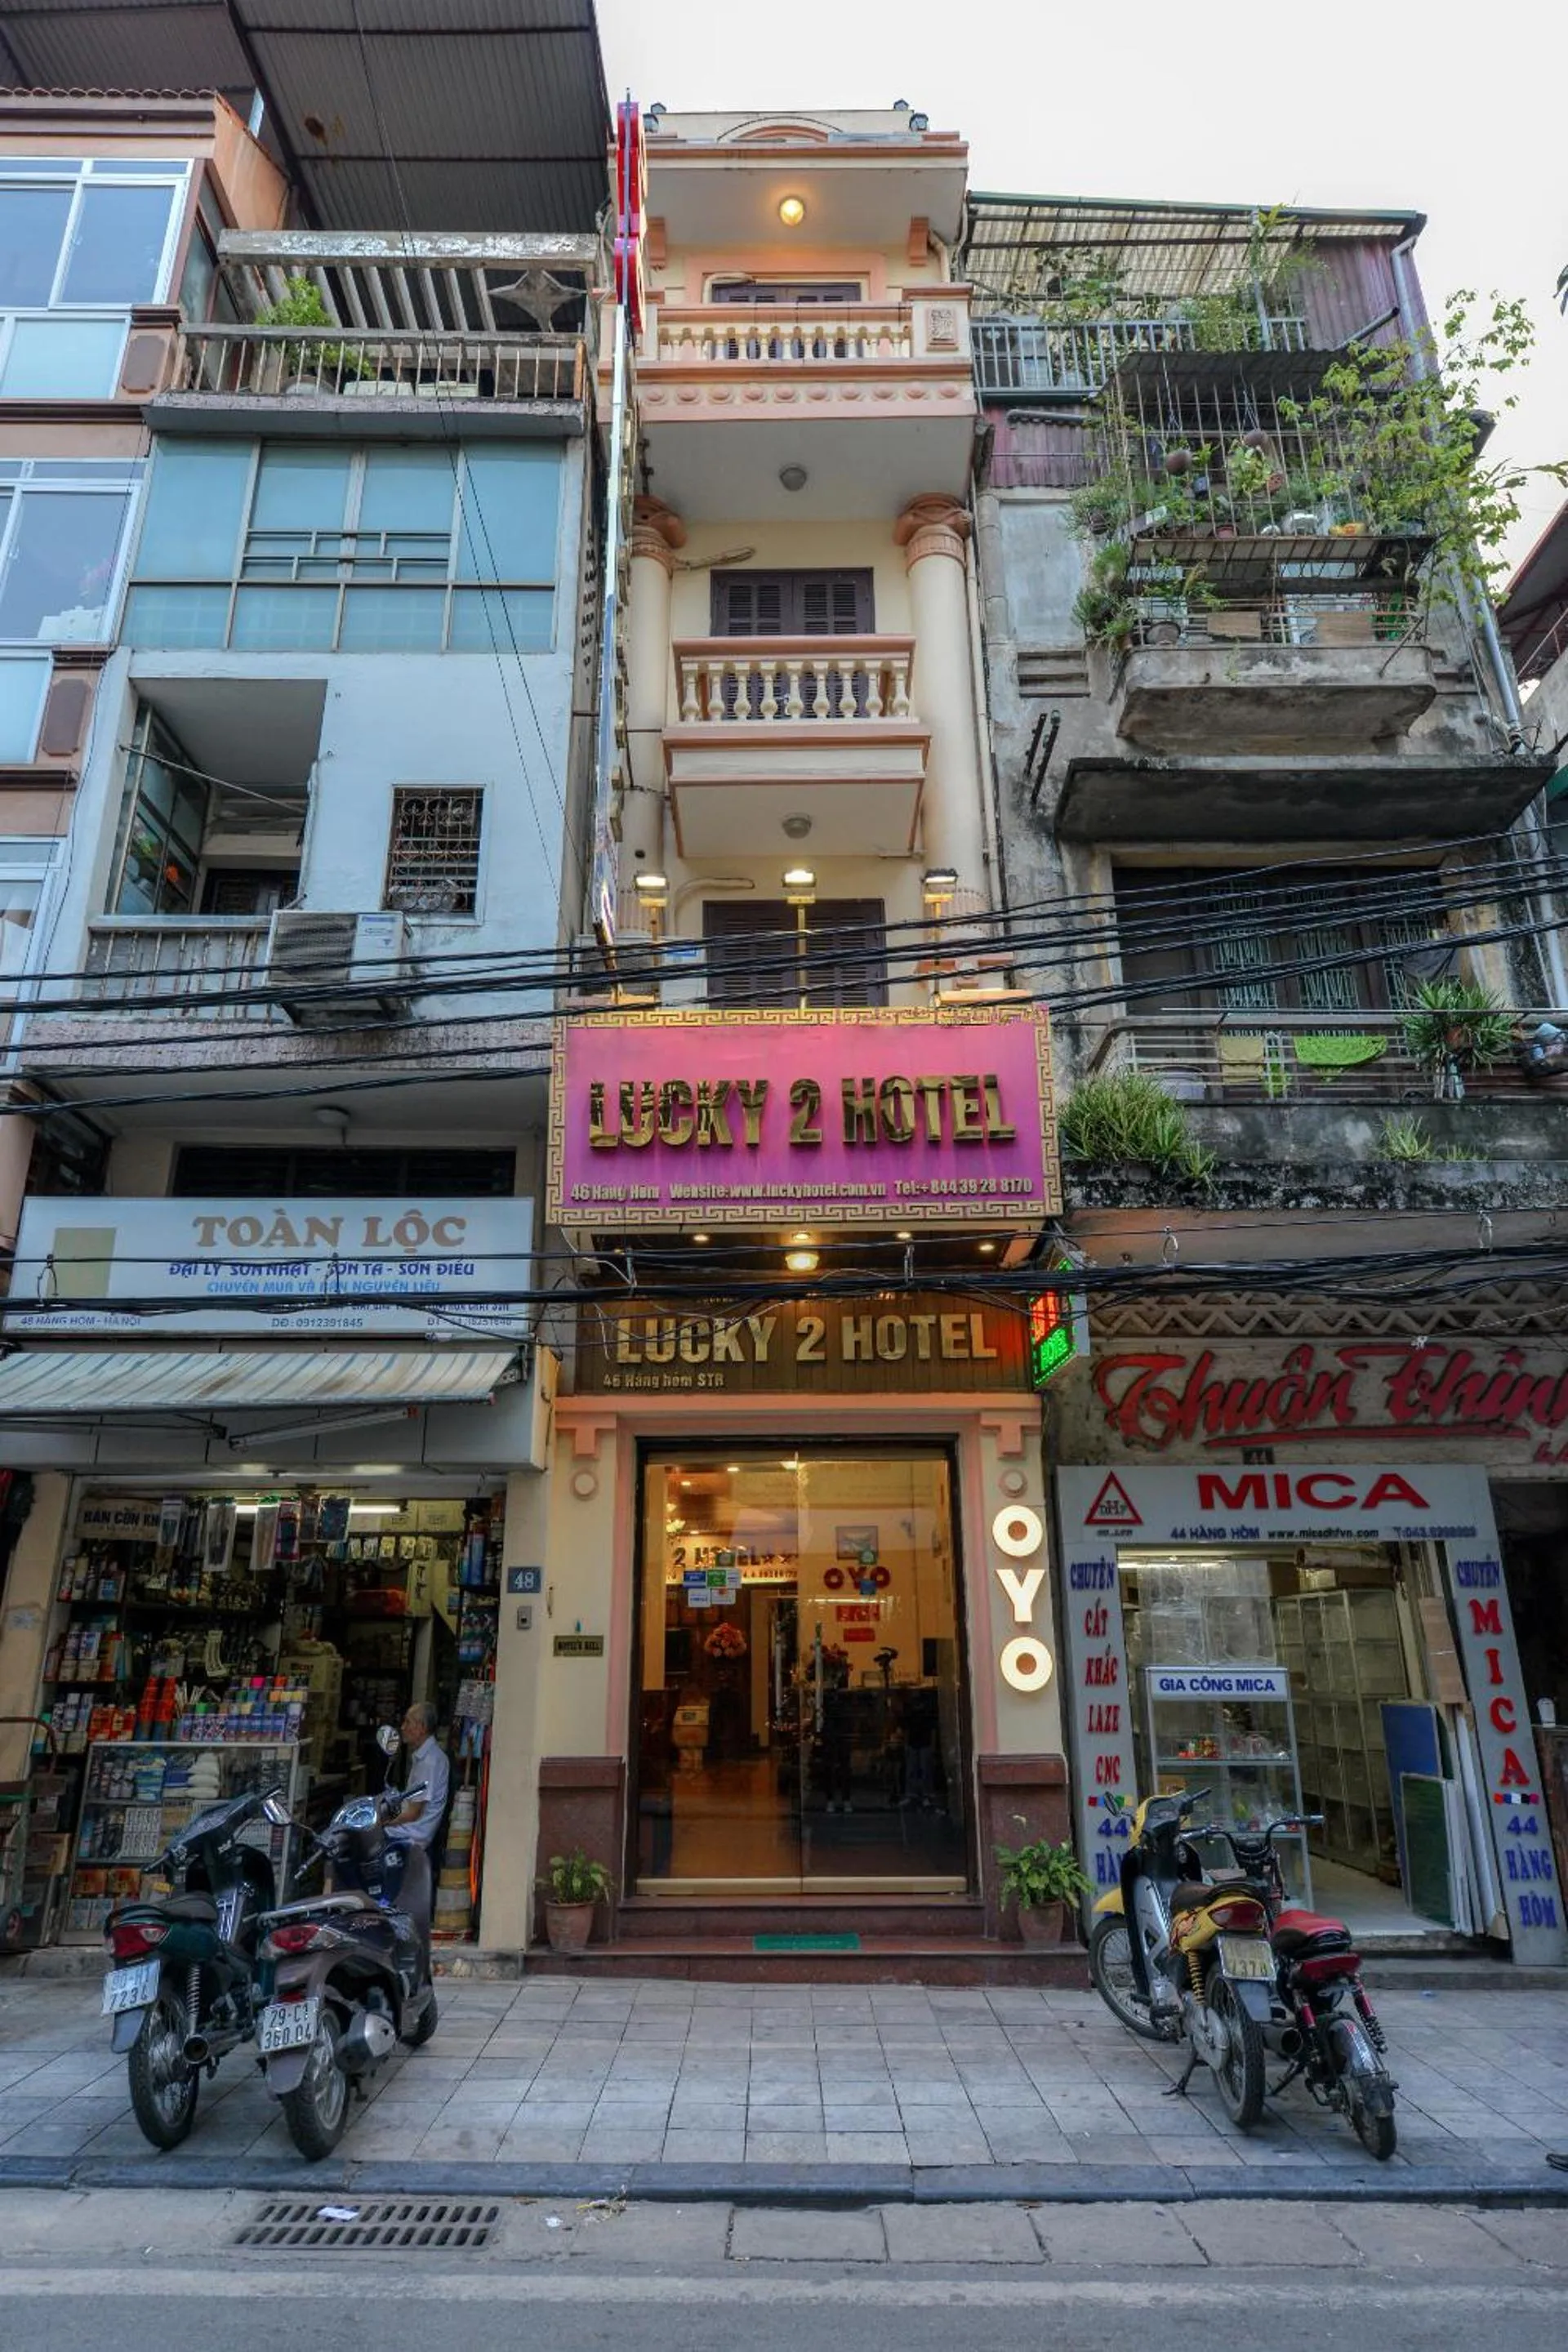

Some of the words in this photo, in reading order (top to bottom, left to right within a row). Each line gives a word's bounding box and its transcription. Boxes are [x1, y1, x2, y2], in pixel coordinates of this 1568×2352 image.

[589, 1079, 768, 1147] LUCKY
[789, 1077, 823, 1145] 2
[841, 1074, 1017, 1143] HOTEL
[572, 1183, 590, 1201] 46
[192, 1208, 345, 1249] TOÀN
[362, 1209, 467, 1254] LỘC
[399, 1262, 432, 1276] SƠN
[616, 1315, 779, 1364] LUCKY
[795, 1316, 826, 1362] 2
[840, 1312, 997, 1362] HOTEL
[603, 1373, 621, 1388] 46
[697, 1372, 724, 1388] STR
[1196, 1472, 1431, 1512] MICA
[1170, 1526, 1187, 1539] 44
[514, 1571, 534, 1590] 48
[1070, 1555, 1116, 1591] CHUYÊN
[1159, 1677, 1187, 1692] GIA
[1189, 1675, 1234, 1692] CÔNG
[1236, 1677, 1276, 1692] MICA
[1087, 1704, 1120, 1733] LAZE
[1095, 1755, 1120, 1784] CNC
[1097, 1817, 1129, 1838] 44
[1507, 1815, 1539, 1837] 44
[1504, 1842, 1553, 1882] HÀNG
[1518, 1889, 1558, 1929] HÒM
